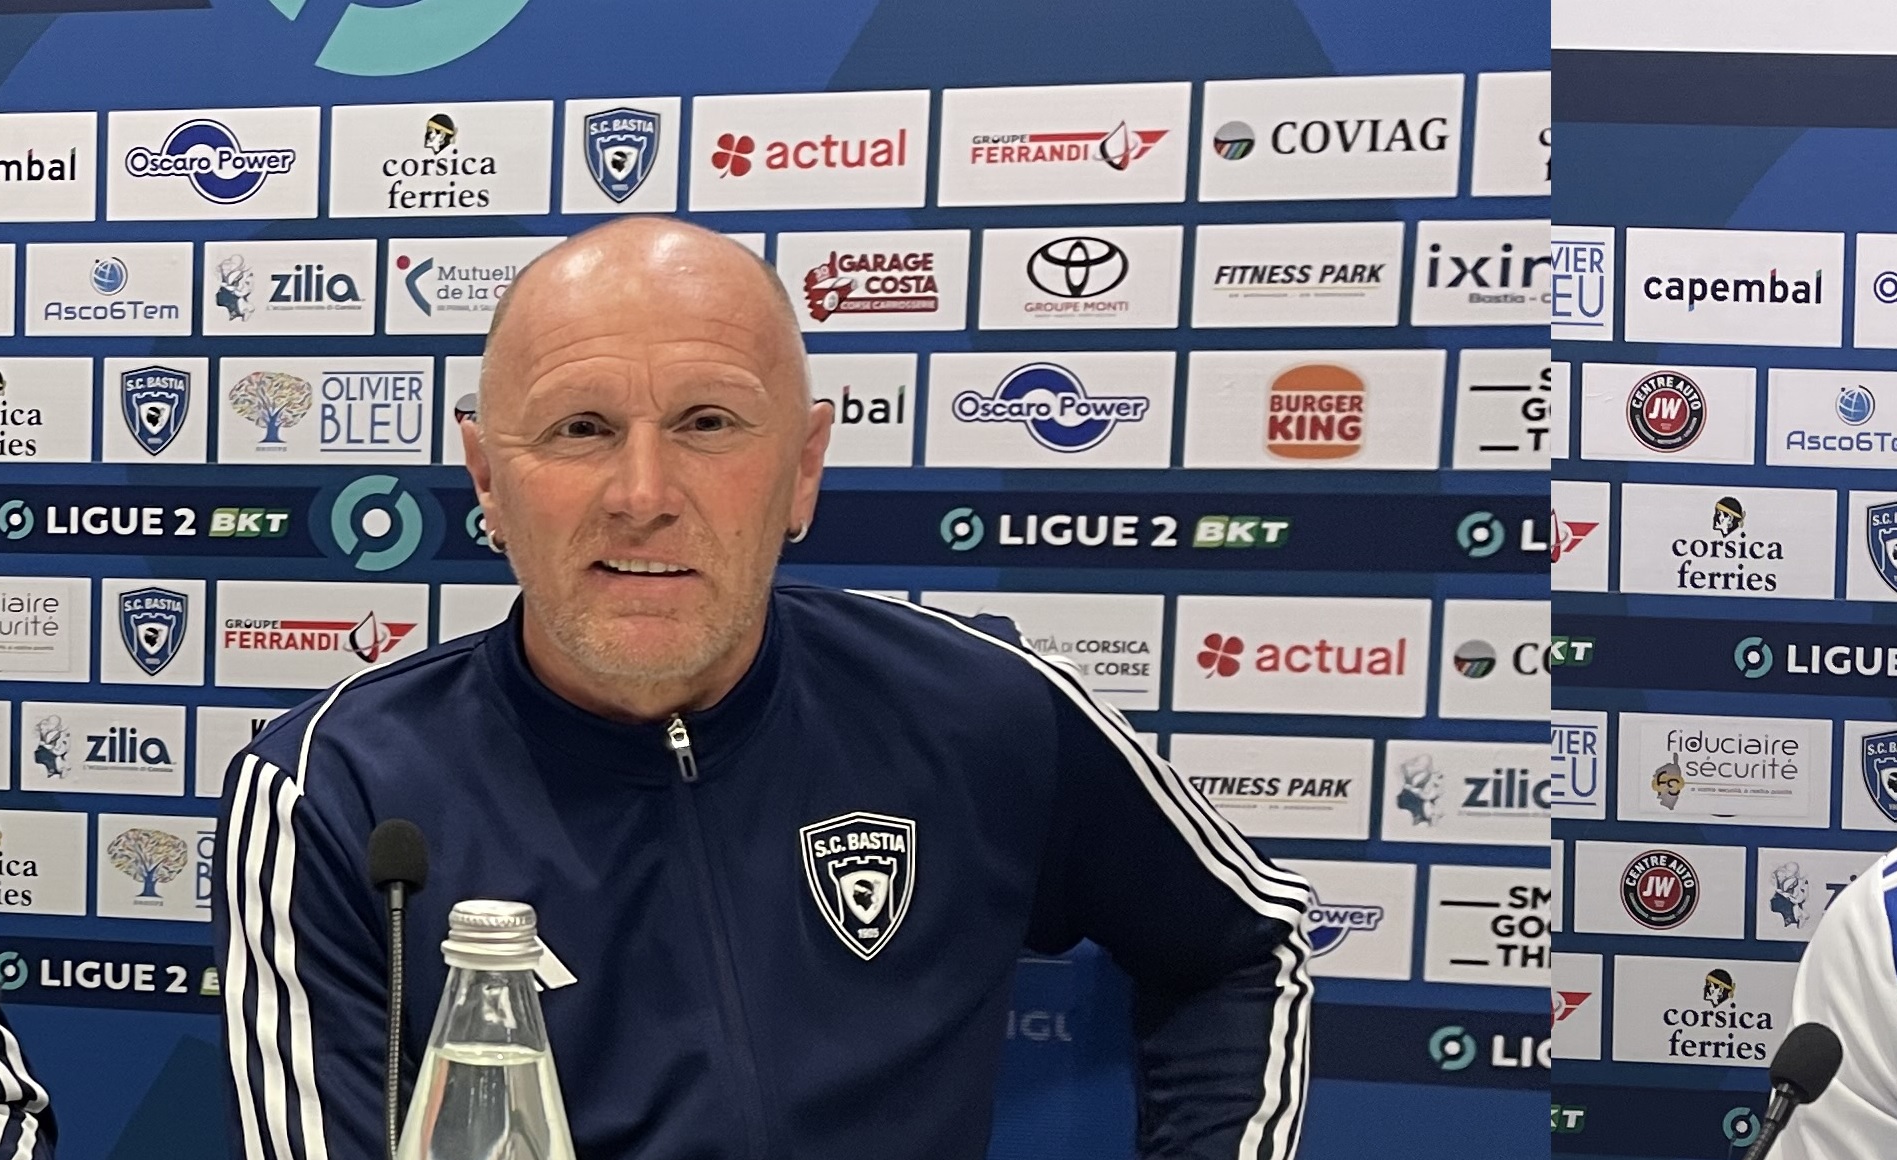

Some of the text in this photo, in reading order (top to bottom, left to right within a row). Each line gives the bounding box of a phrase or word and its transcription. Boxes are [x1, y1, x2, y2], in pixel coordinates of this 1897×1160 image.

[590, 119, 654, 135] S.C. BASTIA
[765, 130, 907, 171] actual
[972, 135, 1027, 145] GROUPE
[383, 151, 497, 177] corsica
[971, 144, 1089, 164] FERRANDI
[387, 180, 490, 209] ferries
[437, 265, 517, 282] Mutuell
[837, 253, 934, 273] GARAGE
[269, 265, 356, 304] zilia
[865, 275, 939, 294] COSTA
[1215, 264, 1384, 286] FITNESS PARK
[1644, 268, 1823, 312] capembal
[44, 301, 179, 321] Asco6Tem
[958, 393, 1146, 420] Oscaro Power
[1270, 394, 1363, 413] BURGER
[1650, 397, 1682, 420] JW
[1269, 414, 1362, 442] KING
[1000, 514, 1287, 547] LIGUE 2 BKT
[1672, 533, 1784, 560] corsica
[1677, 561, 1777, 592] ferries
[225, 619, 279, 629] GROUPE
[224, 630, 339, 651] FERRANDI
[1075, 640, 1150, 655] CORSICA
[1095, 662, 1150, 677] CORSE
[1667, 729, 1799, 756] fiduciaire
[1685, 757, 1799, 781] sécurité
[814, 832, 906, 858] S.C. BASTIA
[41, 960, 189, 994] LIGUE 2
